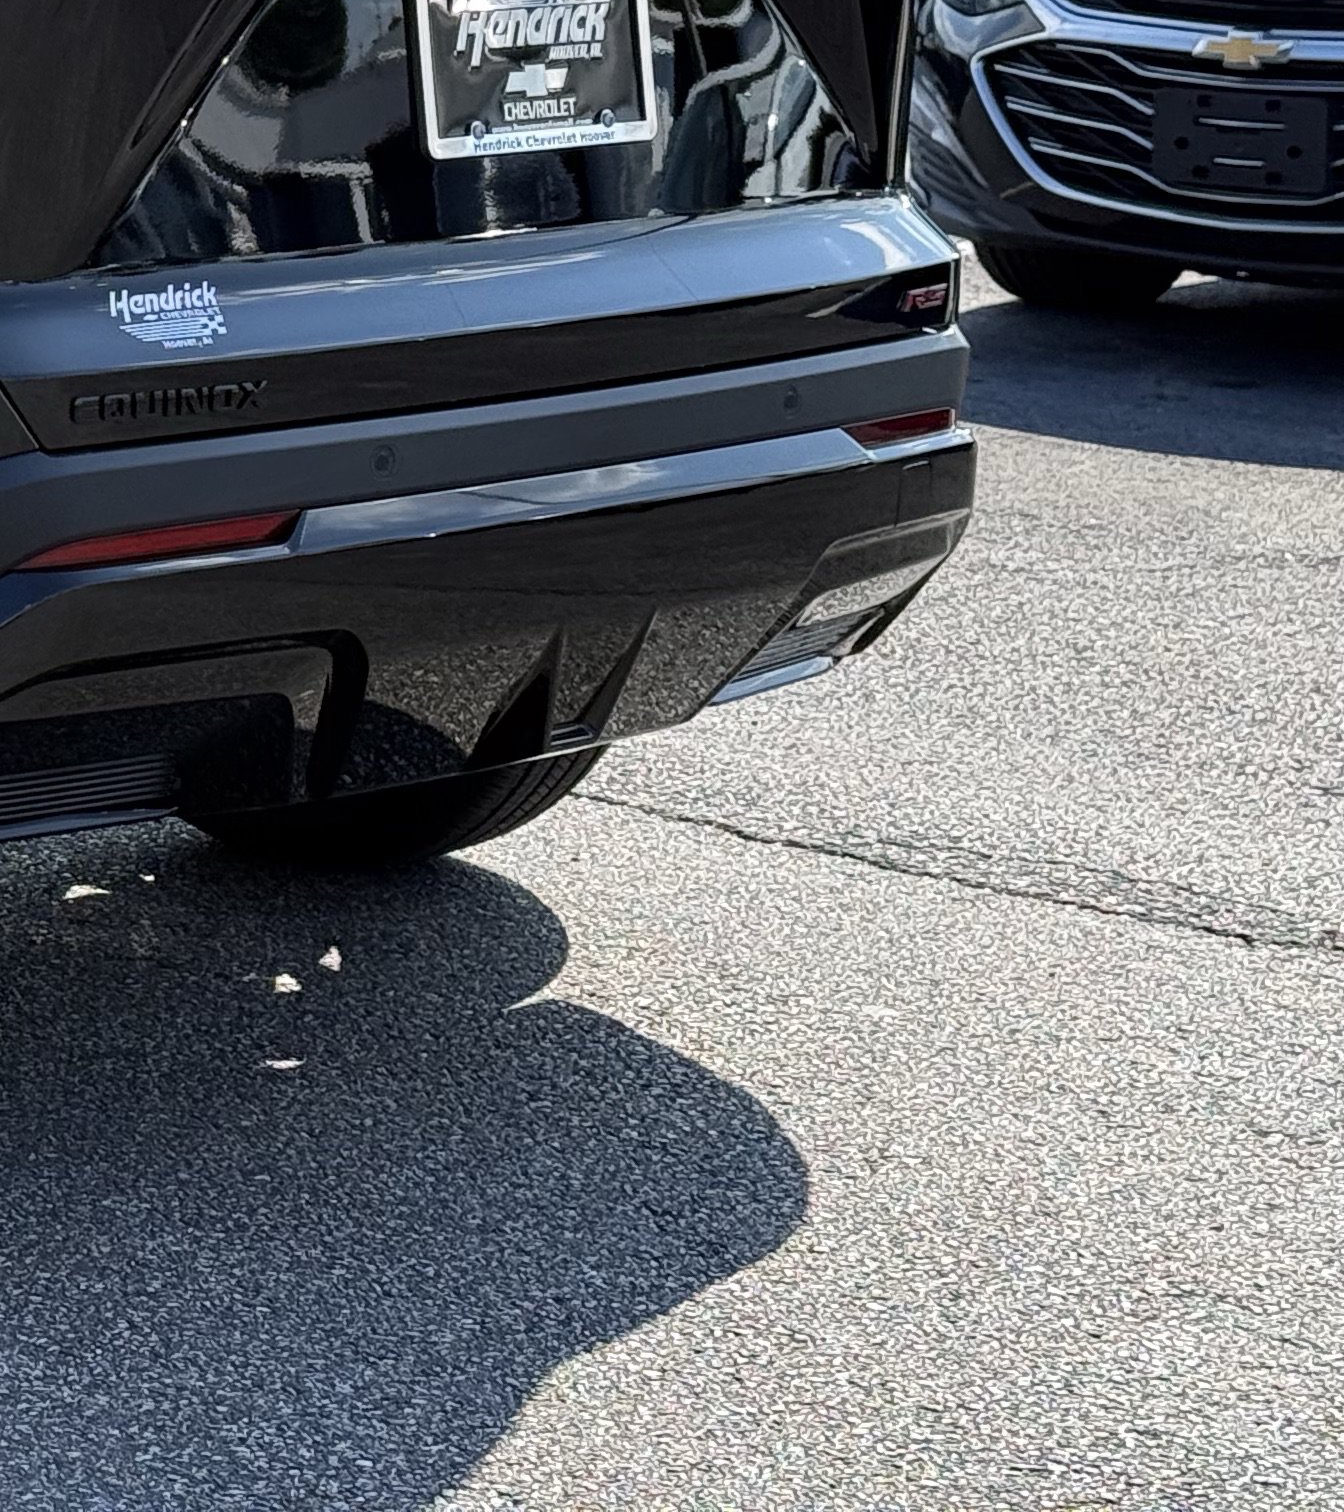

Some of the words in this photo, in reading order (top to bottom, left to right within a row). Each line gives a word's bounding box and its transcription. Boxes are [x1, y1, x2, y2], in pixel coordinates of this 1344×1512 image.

[453, 2, 610, 72] Hendrick
[503, 97, 577, 122] CHEVROLET
[473, 137, 523, 154] Hendrick
[525, 132, 578, 148] Chevrolet
[579, 129, 616, 144] Hoover
[108, 280, 219, 324] Hendrick
[159, 305, 222, 321] CHEVROLET
[900, 282, 949, 313] RS
[68, 380, 268, 424] EQUINOX
